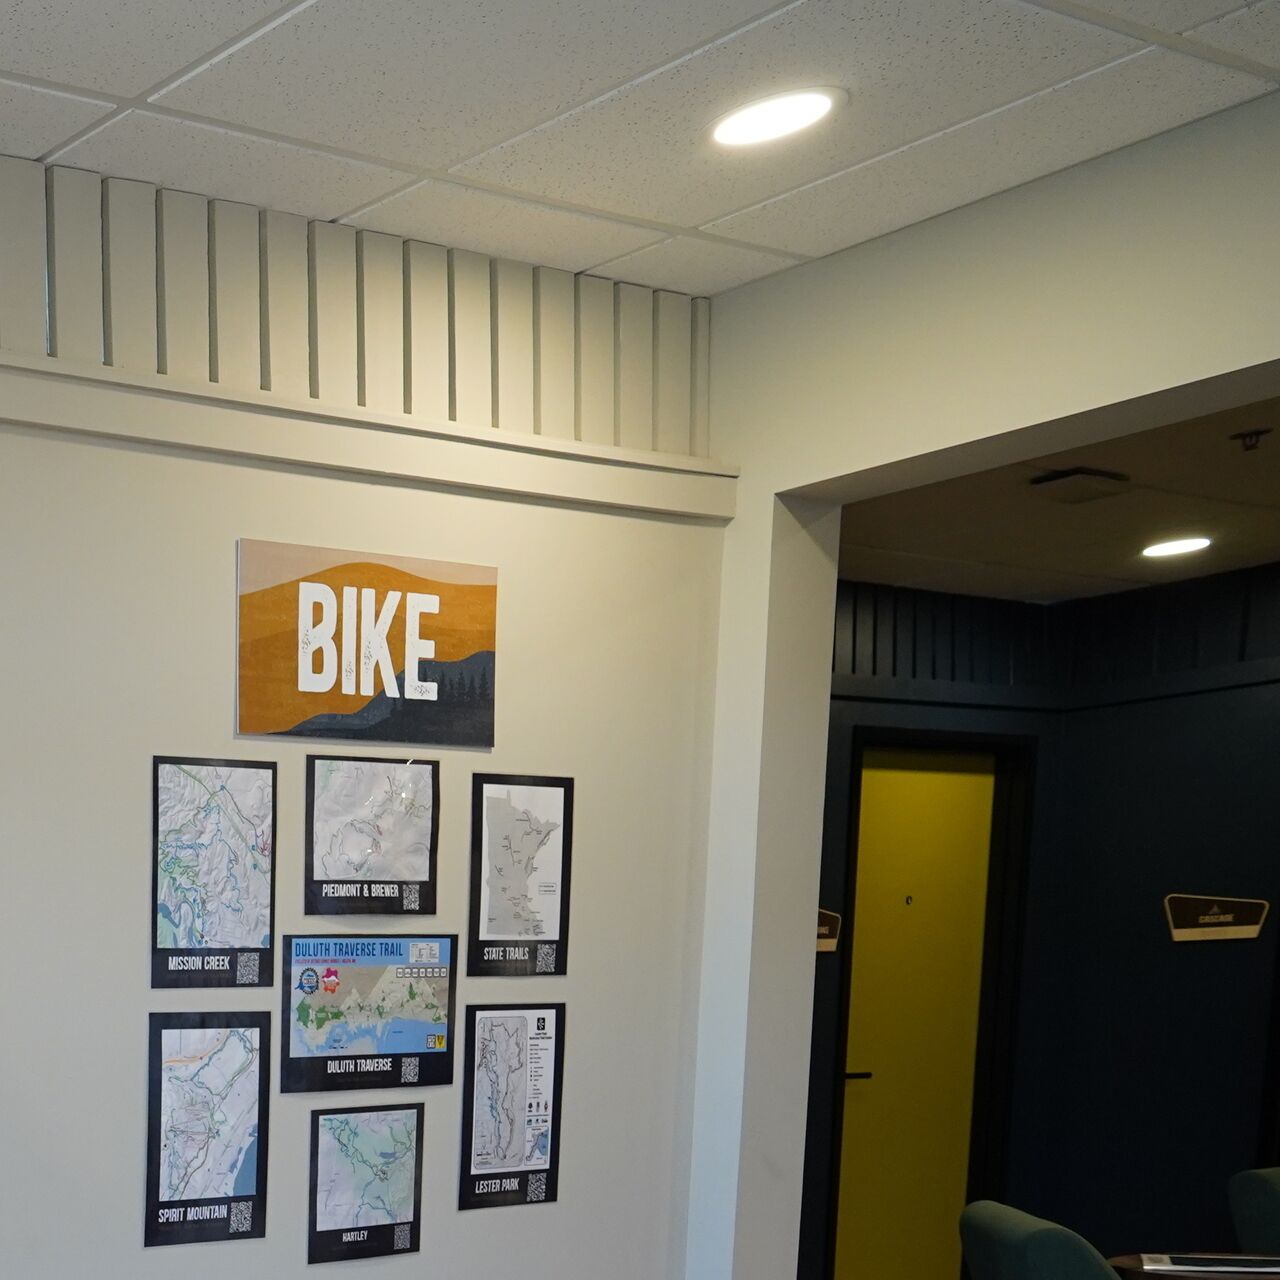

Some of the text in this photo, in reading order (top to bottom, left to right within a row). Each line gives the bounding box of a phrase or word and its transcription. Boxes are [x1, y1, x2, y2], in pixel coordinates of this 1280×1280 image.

[297, 581, 440, 700] BIKE
[322, 883, 400, 898] PIEDMONT & BREWER
[295, 942, 404, 958] DULUTH TRAVERSE TRAIL
[484, 947, 529, 962] STATE TRAILS
[168, 955, 230, 971] MISSION CREEK
[328, 1058, 392, 1074] DULUTH TRAVERSE
[476, 1178, 520, 1194] LESTER PARK
[158, 1204, 228, 1223] SPIRIT MOUNTAIN
[342, 1230, 368, 1242] HARTLEY
